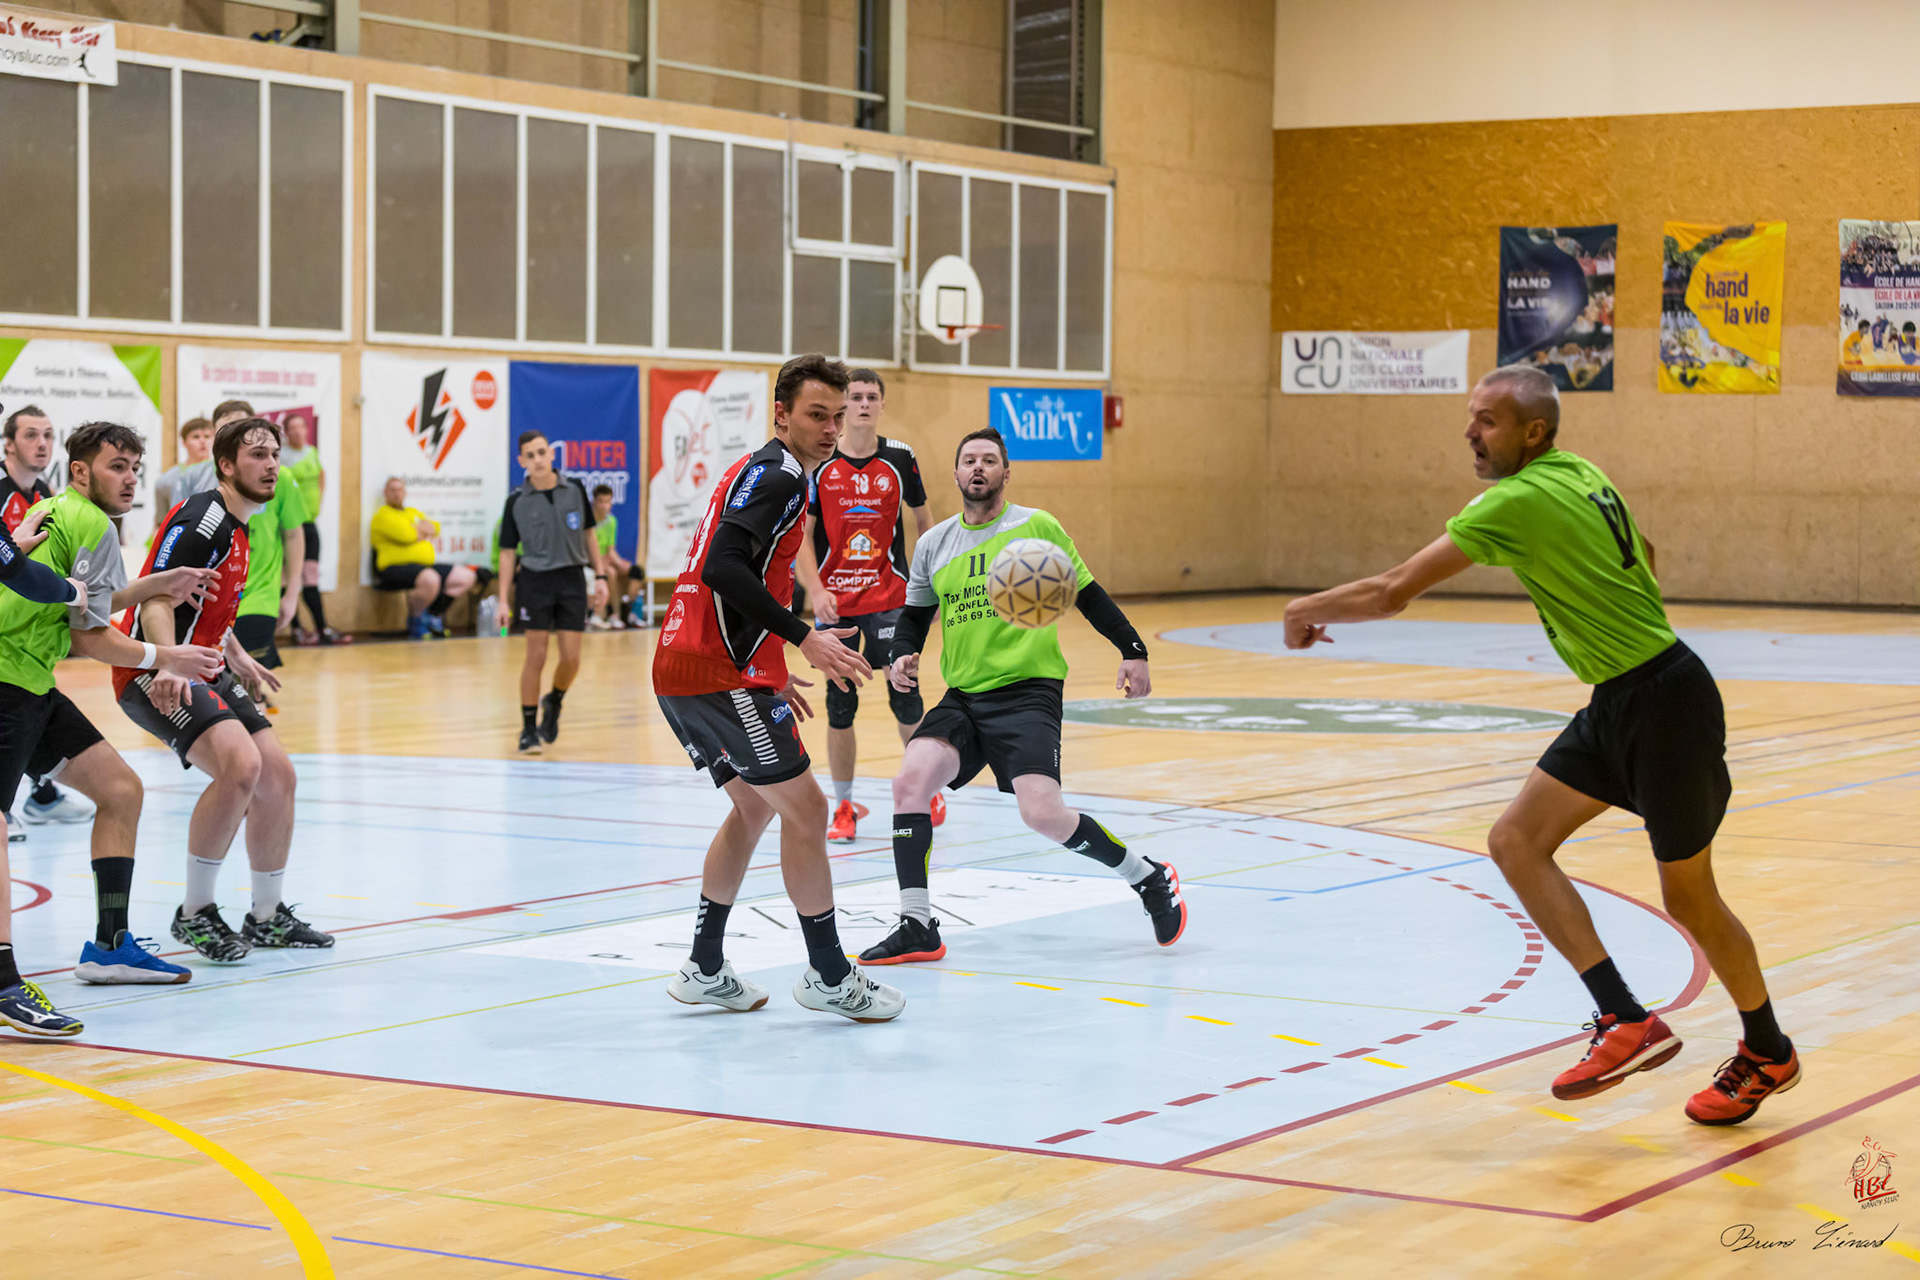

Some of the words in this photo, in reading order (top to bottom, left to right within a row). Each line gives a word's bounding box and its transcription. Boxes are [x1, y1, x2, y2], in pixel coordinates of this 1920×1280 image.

[1507, 277, 1551, 290] HAND
[1705, 272, 1748, 298] hand
[1507, 298, 1526, 309] LA
[1724, 300, 1739, 325] la
[1744, 300, 1770, 324] vie
[1350, 349, 1424, 361] NATIONALE
[1379, 363, 1424, 376] CLUBS
[1350, 376, 1458, 390] UNIVERSITAIRES
[565, 440, 626, 468] INTER
[851, 473, 869, 495] 18
[839, 497, 853, 507] Guy
[968, 553, 986, 578] 11
[957, 614, 968, 624] 38
[970, 611, 983, 621] 69
